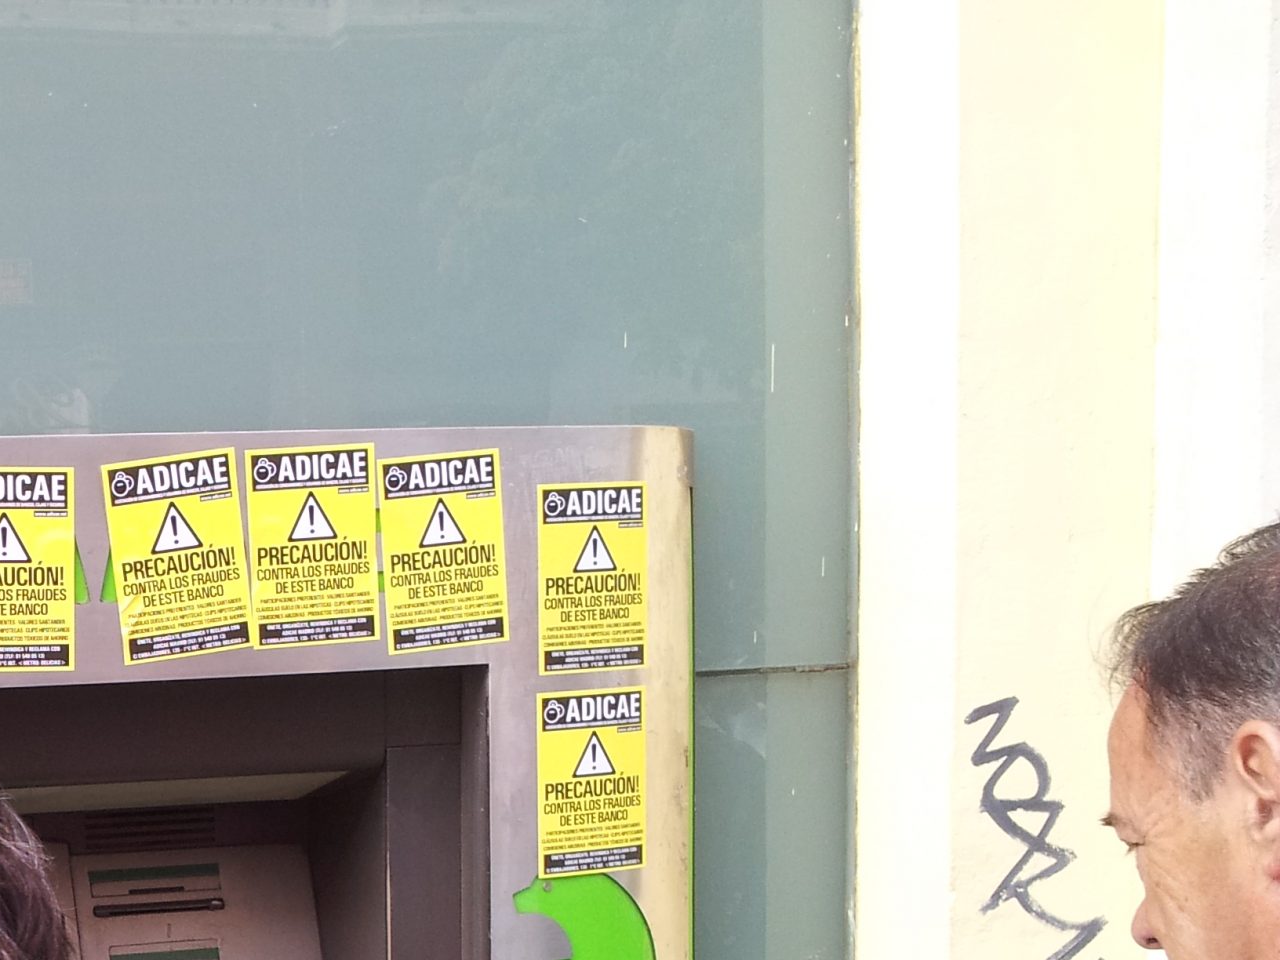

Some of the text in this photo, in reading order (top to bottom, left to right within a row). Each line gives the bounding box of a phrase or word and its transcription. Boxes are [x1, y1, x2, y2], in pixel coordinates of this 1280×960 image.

[136, 455, 228, 495] ADICAE
[277, 450, 366, 482] ADICAE
[408, 456, 493, 489] ADICAE
[566, 488, 643, 515] ADICAE
[121, 543, 236, 582] PRECAUCIÓN!
[257, 535, 367, 567] PRECAUCIÓN!
[390, 539, 496, 573] PRECAUCIÓN!
[122, 567, 240, 596] CONTRA LOS FRAUDES
[256, 560, 371, 581] CONTRA LOS FRAUDES
[390, 563, 499, 587] CONTRA LOS FRAUDES
[545, 567, 642, 596] PRECAUCIÓN!
[15, 587, 67, 601] FRAUDES
[142, 583, 224, 608] DE ESTE BANCO
[275, 576, 354, 594] DE ESTE BANCO
[407, 579, 483, 600] DE ESTE BANCO
[8, 602, 48, 616] BANCO
[544, 592, 644, 610] CONTRA LOS FRAUDES
[560, 606, 629, 623] DE ESTE BANCO
[565, 693, 642, 722] ADICAE
[545, 771, 640, 801] PRECAUCIÓN!
[544, 794, 642, 815] CONTRA LOS FRAUDES
[559, 808, 628, 827] DE ESTE BANCO
